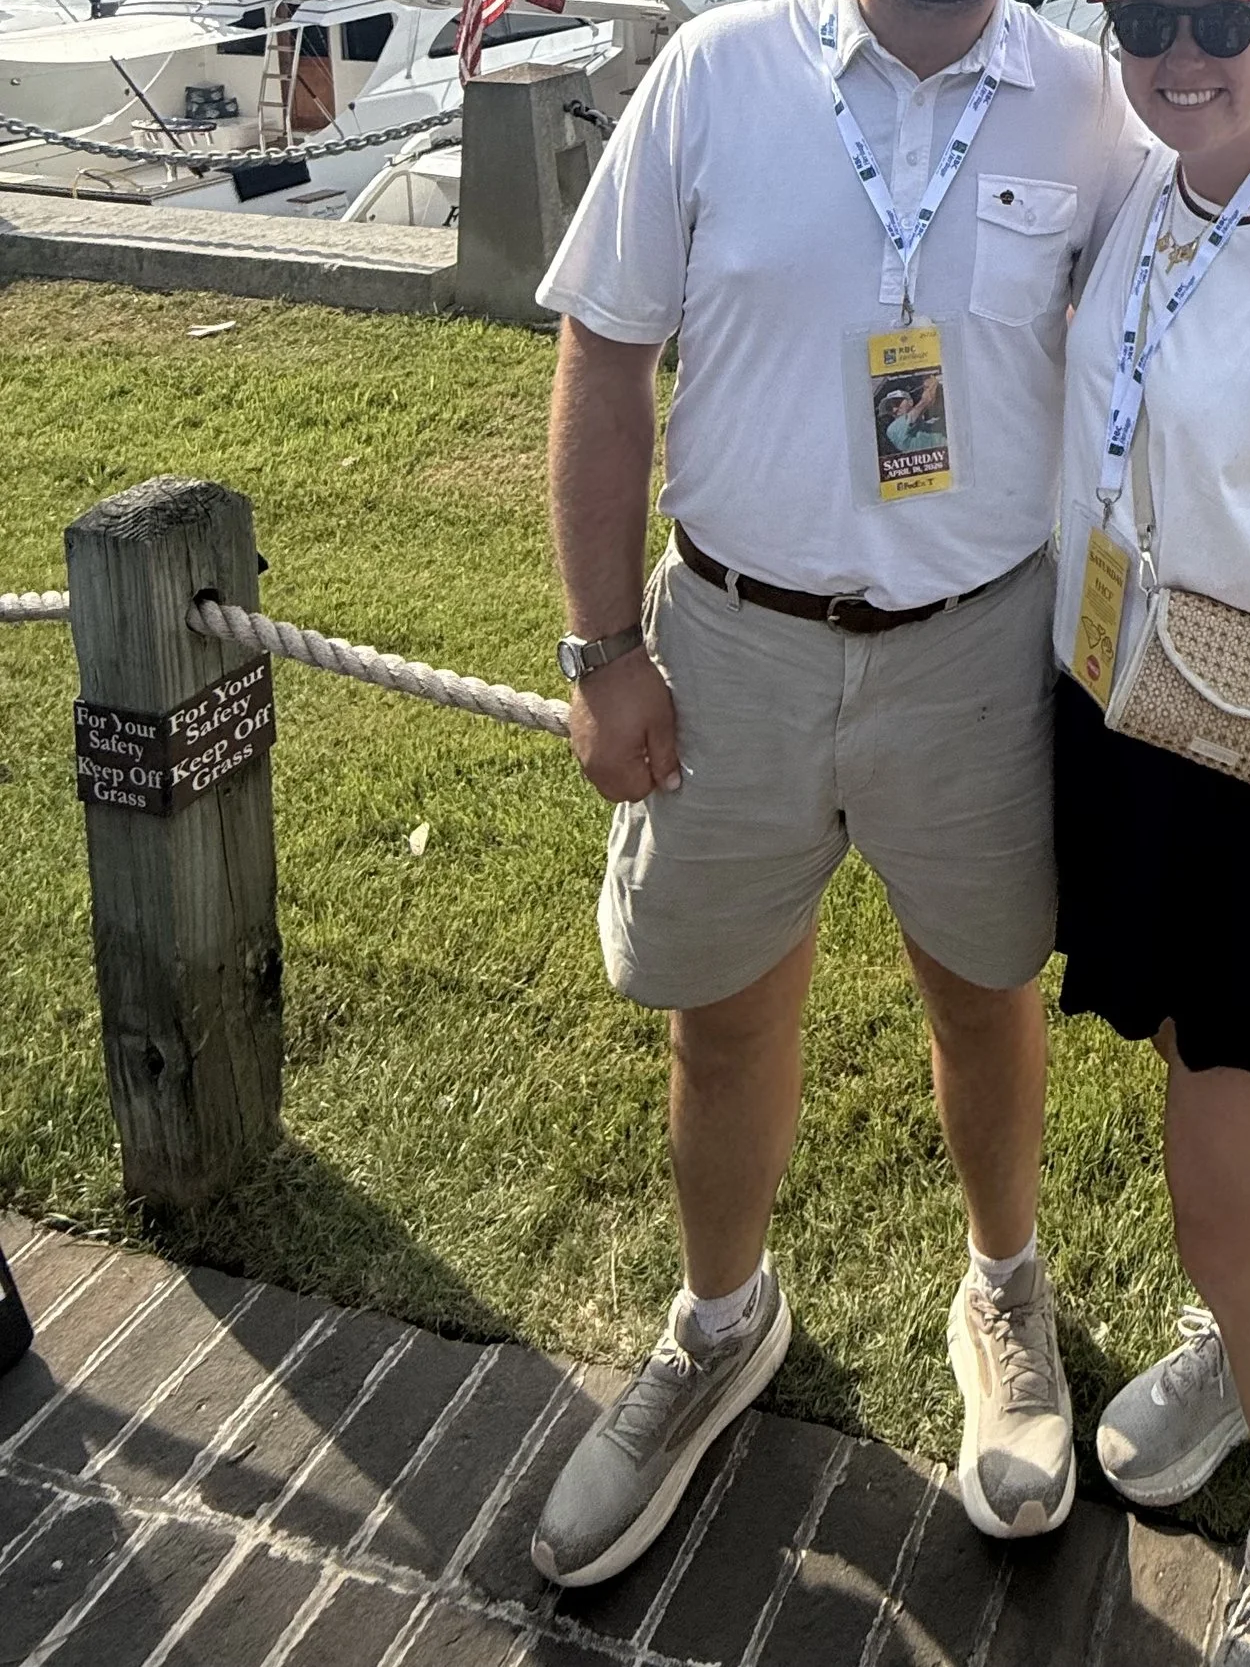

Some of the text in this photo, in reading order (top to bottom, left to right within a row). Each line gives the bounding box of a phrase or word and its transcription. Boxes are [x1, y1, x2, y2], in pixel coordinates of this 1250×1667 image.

[983, 90, 993, 106] RBC
[853, 154, 863, 169] RBC
[951, 155, 962, 170] RBC
[1216, 215, 1229, 231] RBC
[1112, 425, 1122, 442] RBC
[883, 450, 946, 471] SATURDAY
[169, 665, 265, 737] For Your
[75, 706, 108, 731] For
[185, 694, 252, 745] Safety
[89, 730, 144, 762] Safety
[171, 703, 272, 786] Keep Off
[77, 756, 163, 789] Keep Off
[192, 743, 254, 792] Grass
[93, 781, 147, 808] Grass
